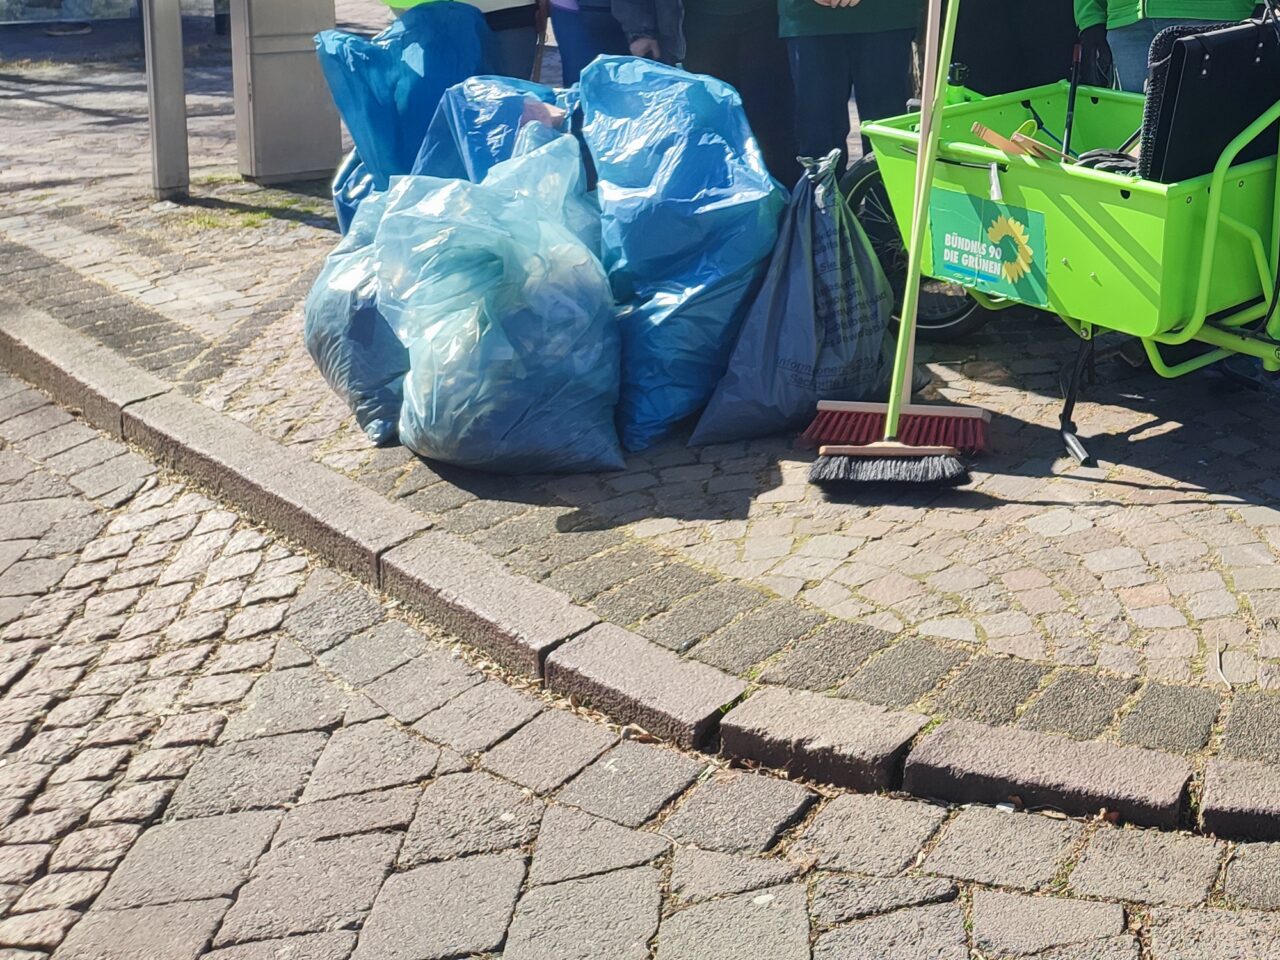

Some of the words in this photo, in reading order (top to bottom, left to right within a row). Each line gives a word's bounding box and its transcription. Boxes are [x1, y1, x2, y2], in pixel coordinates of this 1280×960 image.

[944, 232, 987, 256] BÜNDNIS
[988, 245, 1003, 260] 90
[943, 248, 959, 264] DIE
[961, 253, 1002, 276] GRÜNEN
